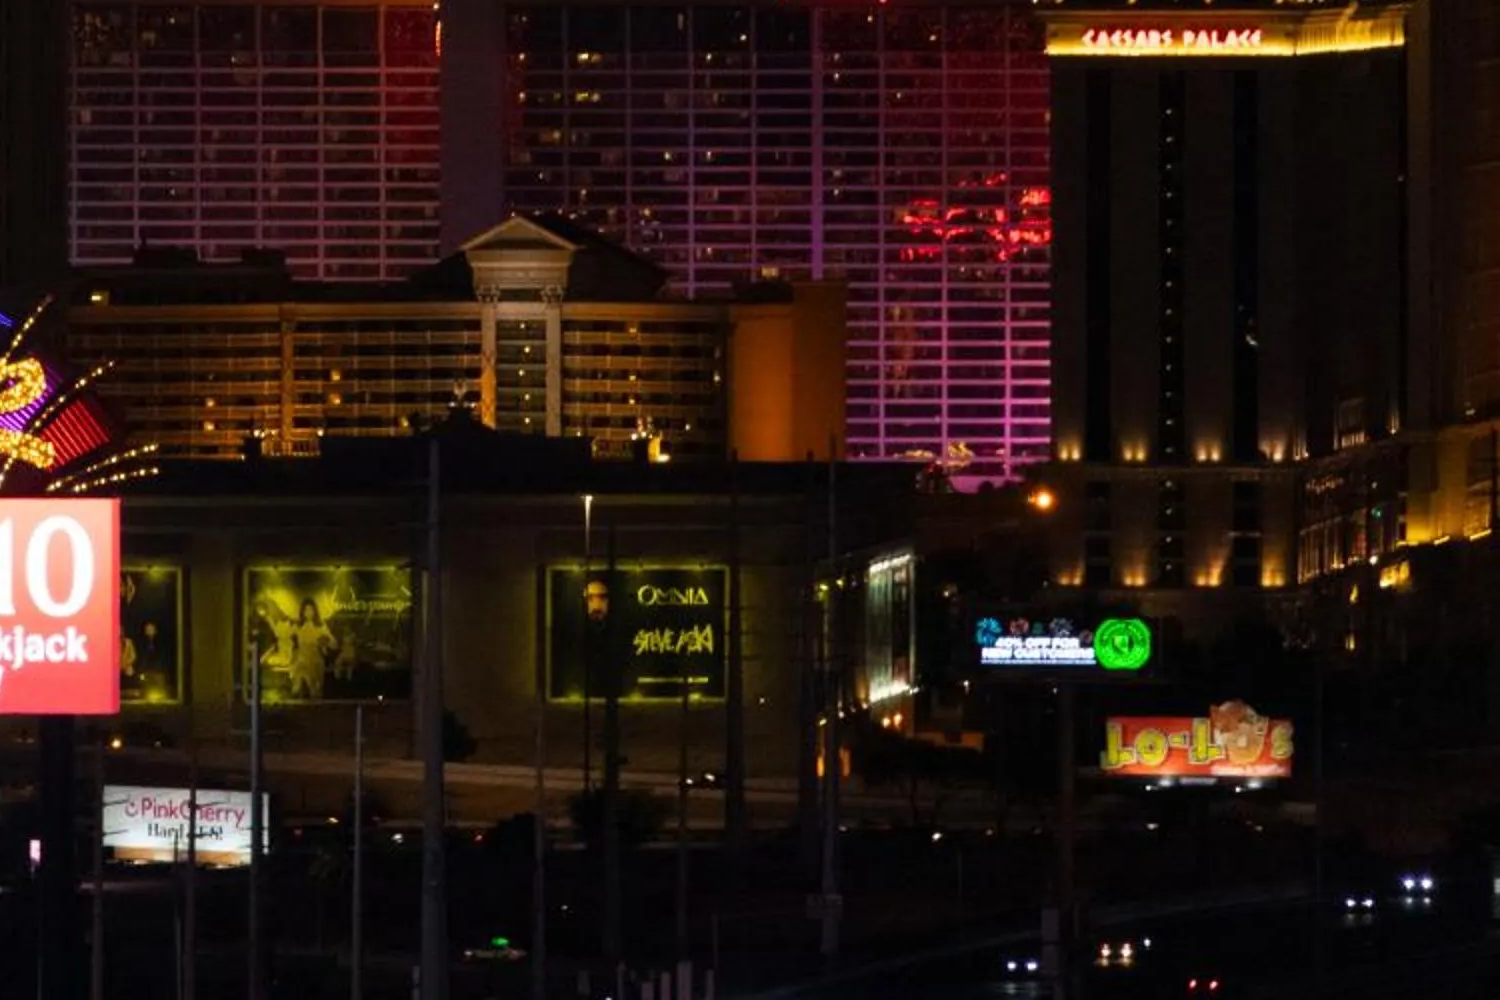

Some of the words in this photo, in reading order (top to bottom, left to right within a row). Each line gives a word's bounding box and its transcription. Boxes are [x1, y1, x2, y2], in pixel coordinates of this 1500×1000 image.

[1081, 29, 1172, 48] CAESARS
[1182, 29, 1262, 48] PALACE
[636, 583, 709, 606] OMNIA
